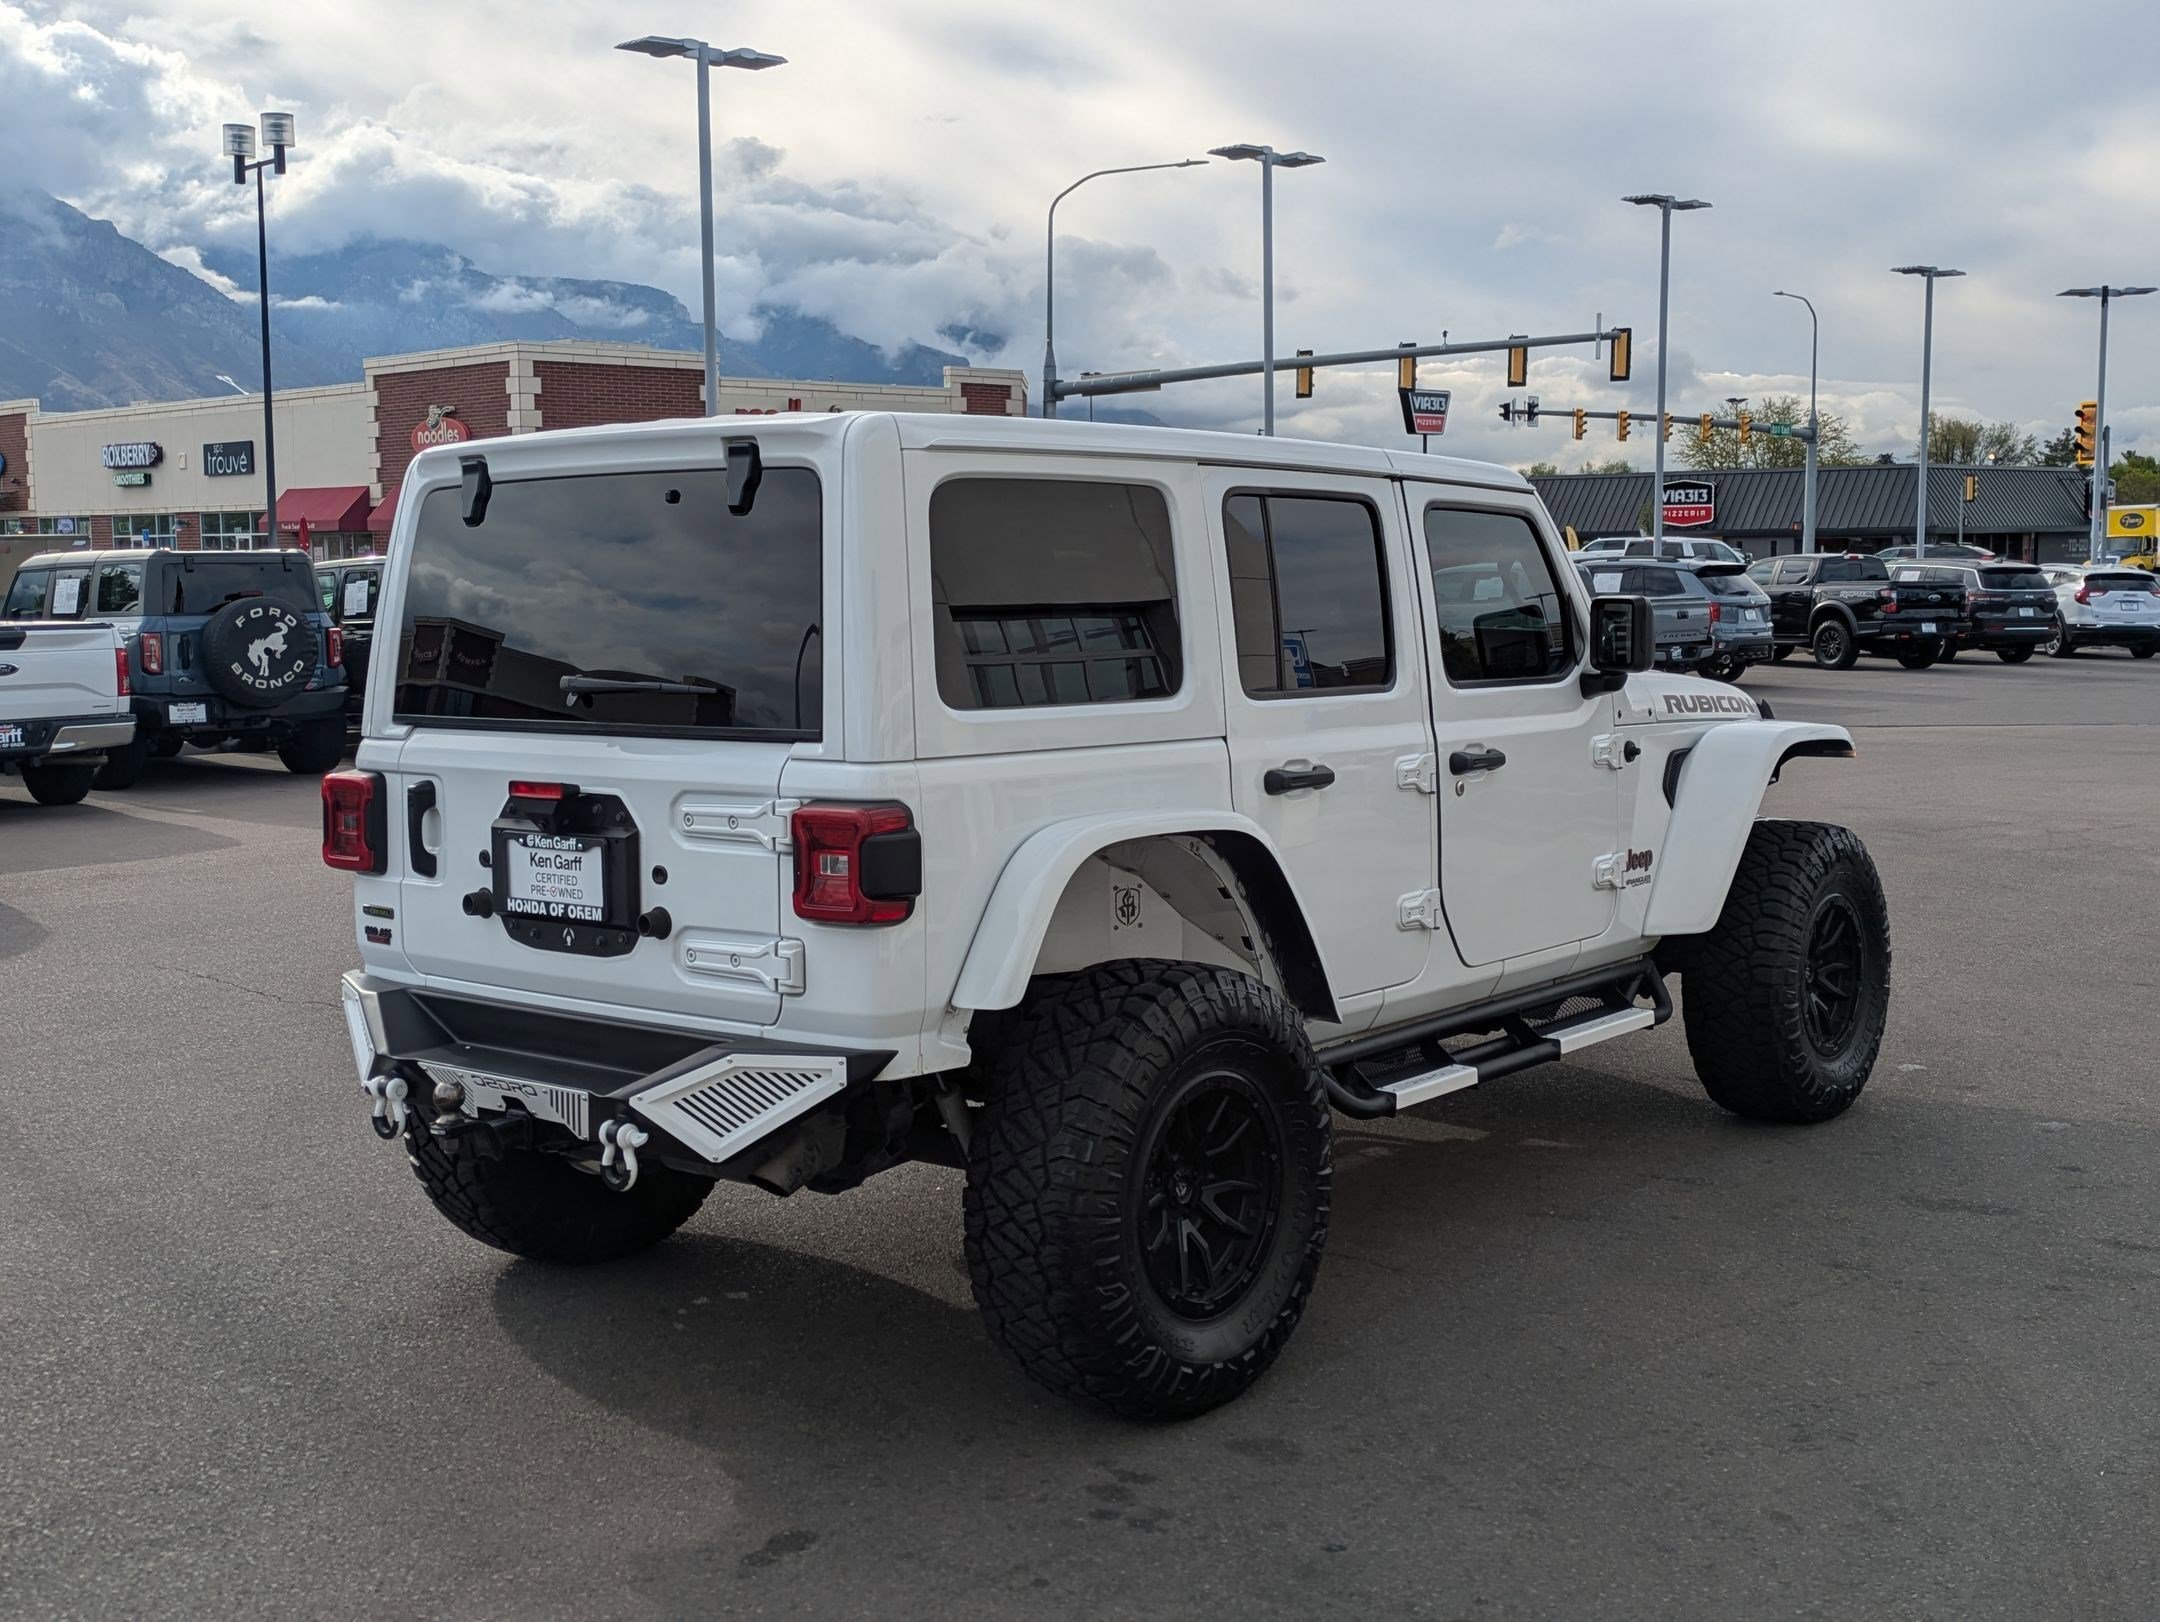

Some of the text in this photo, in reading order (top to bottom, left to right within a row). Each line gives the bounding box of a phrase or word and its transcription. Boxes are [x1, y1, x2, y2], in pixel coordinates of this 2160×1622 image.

[417, 421, 459, 444] noodles
[103, 444, 150, 467] ROXBERRY
[213, 444, 223, 455] spa
[113, 473, 145, 485] SMOOTHIES
[235, 607, 297, 628] FORD
[231, 660, 304, 689] BRONCO
[1663, 695, 1756, 713] RUBICON
[0, 728, 22, 743] arff
[534, 835, 576, 850] Ken Garff
[529, 852, 582, 871] Ken Garff
[1626, 849, 1653, 872] Jeep
[535, 872, 578, 886] CERTIFIED
[507, 898, 602, 921] HONDA OF OREM
